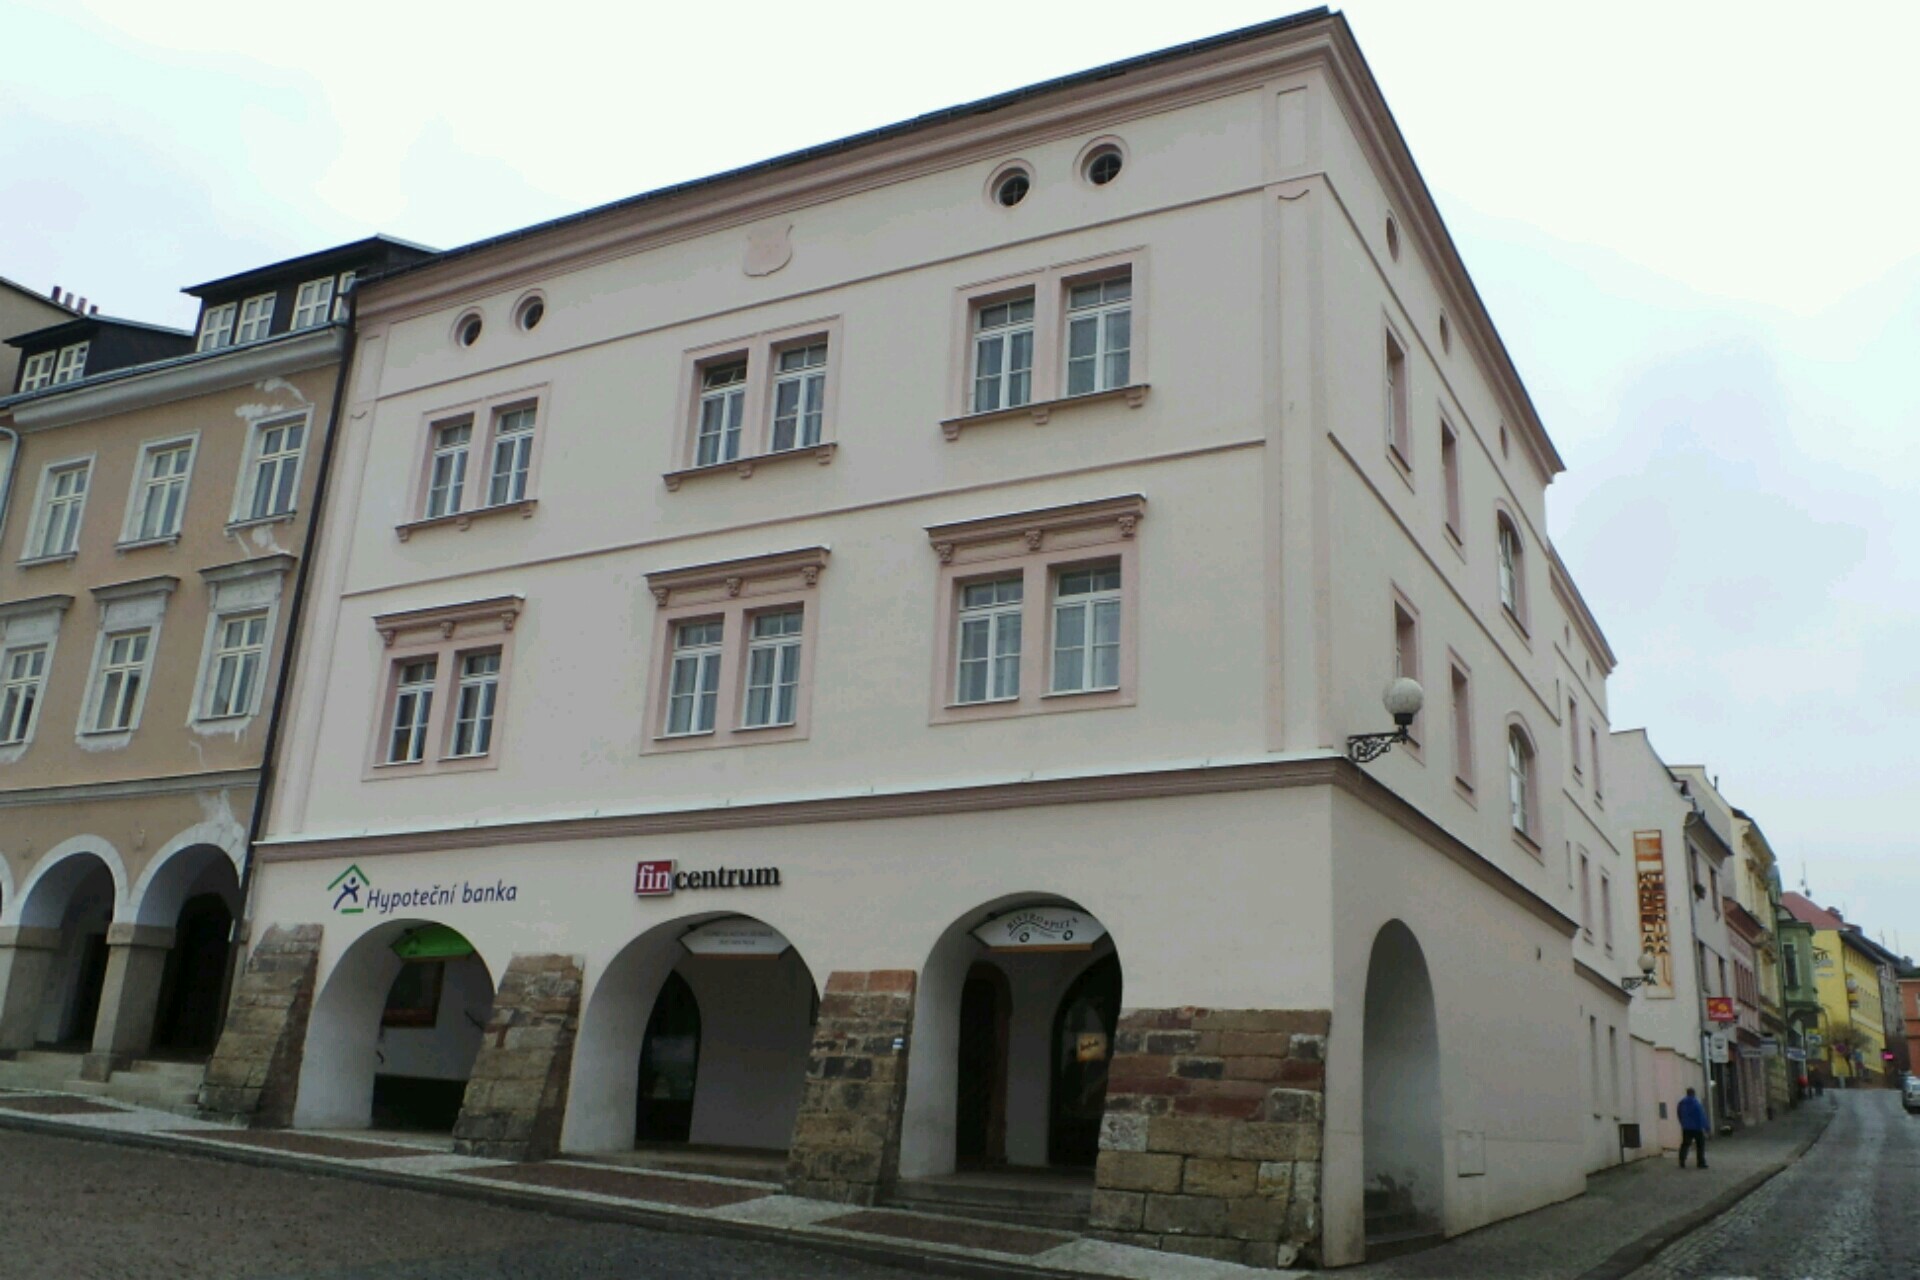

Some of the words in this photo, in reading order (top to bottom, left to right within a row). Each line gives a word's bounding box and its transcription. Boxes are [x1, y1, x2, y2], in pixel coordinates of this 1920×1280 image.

[637, 863, 782, 891] fincentrum
[366, 884, 457, 914] Hypoteční
[462, 879, 517, 904] banka
